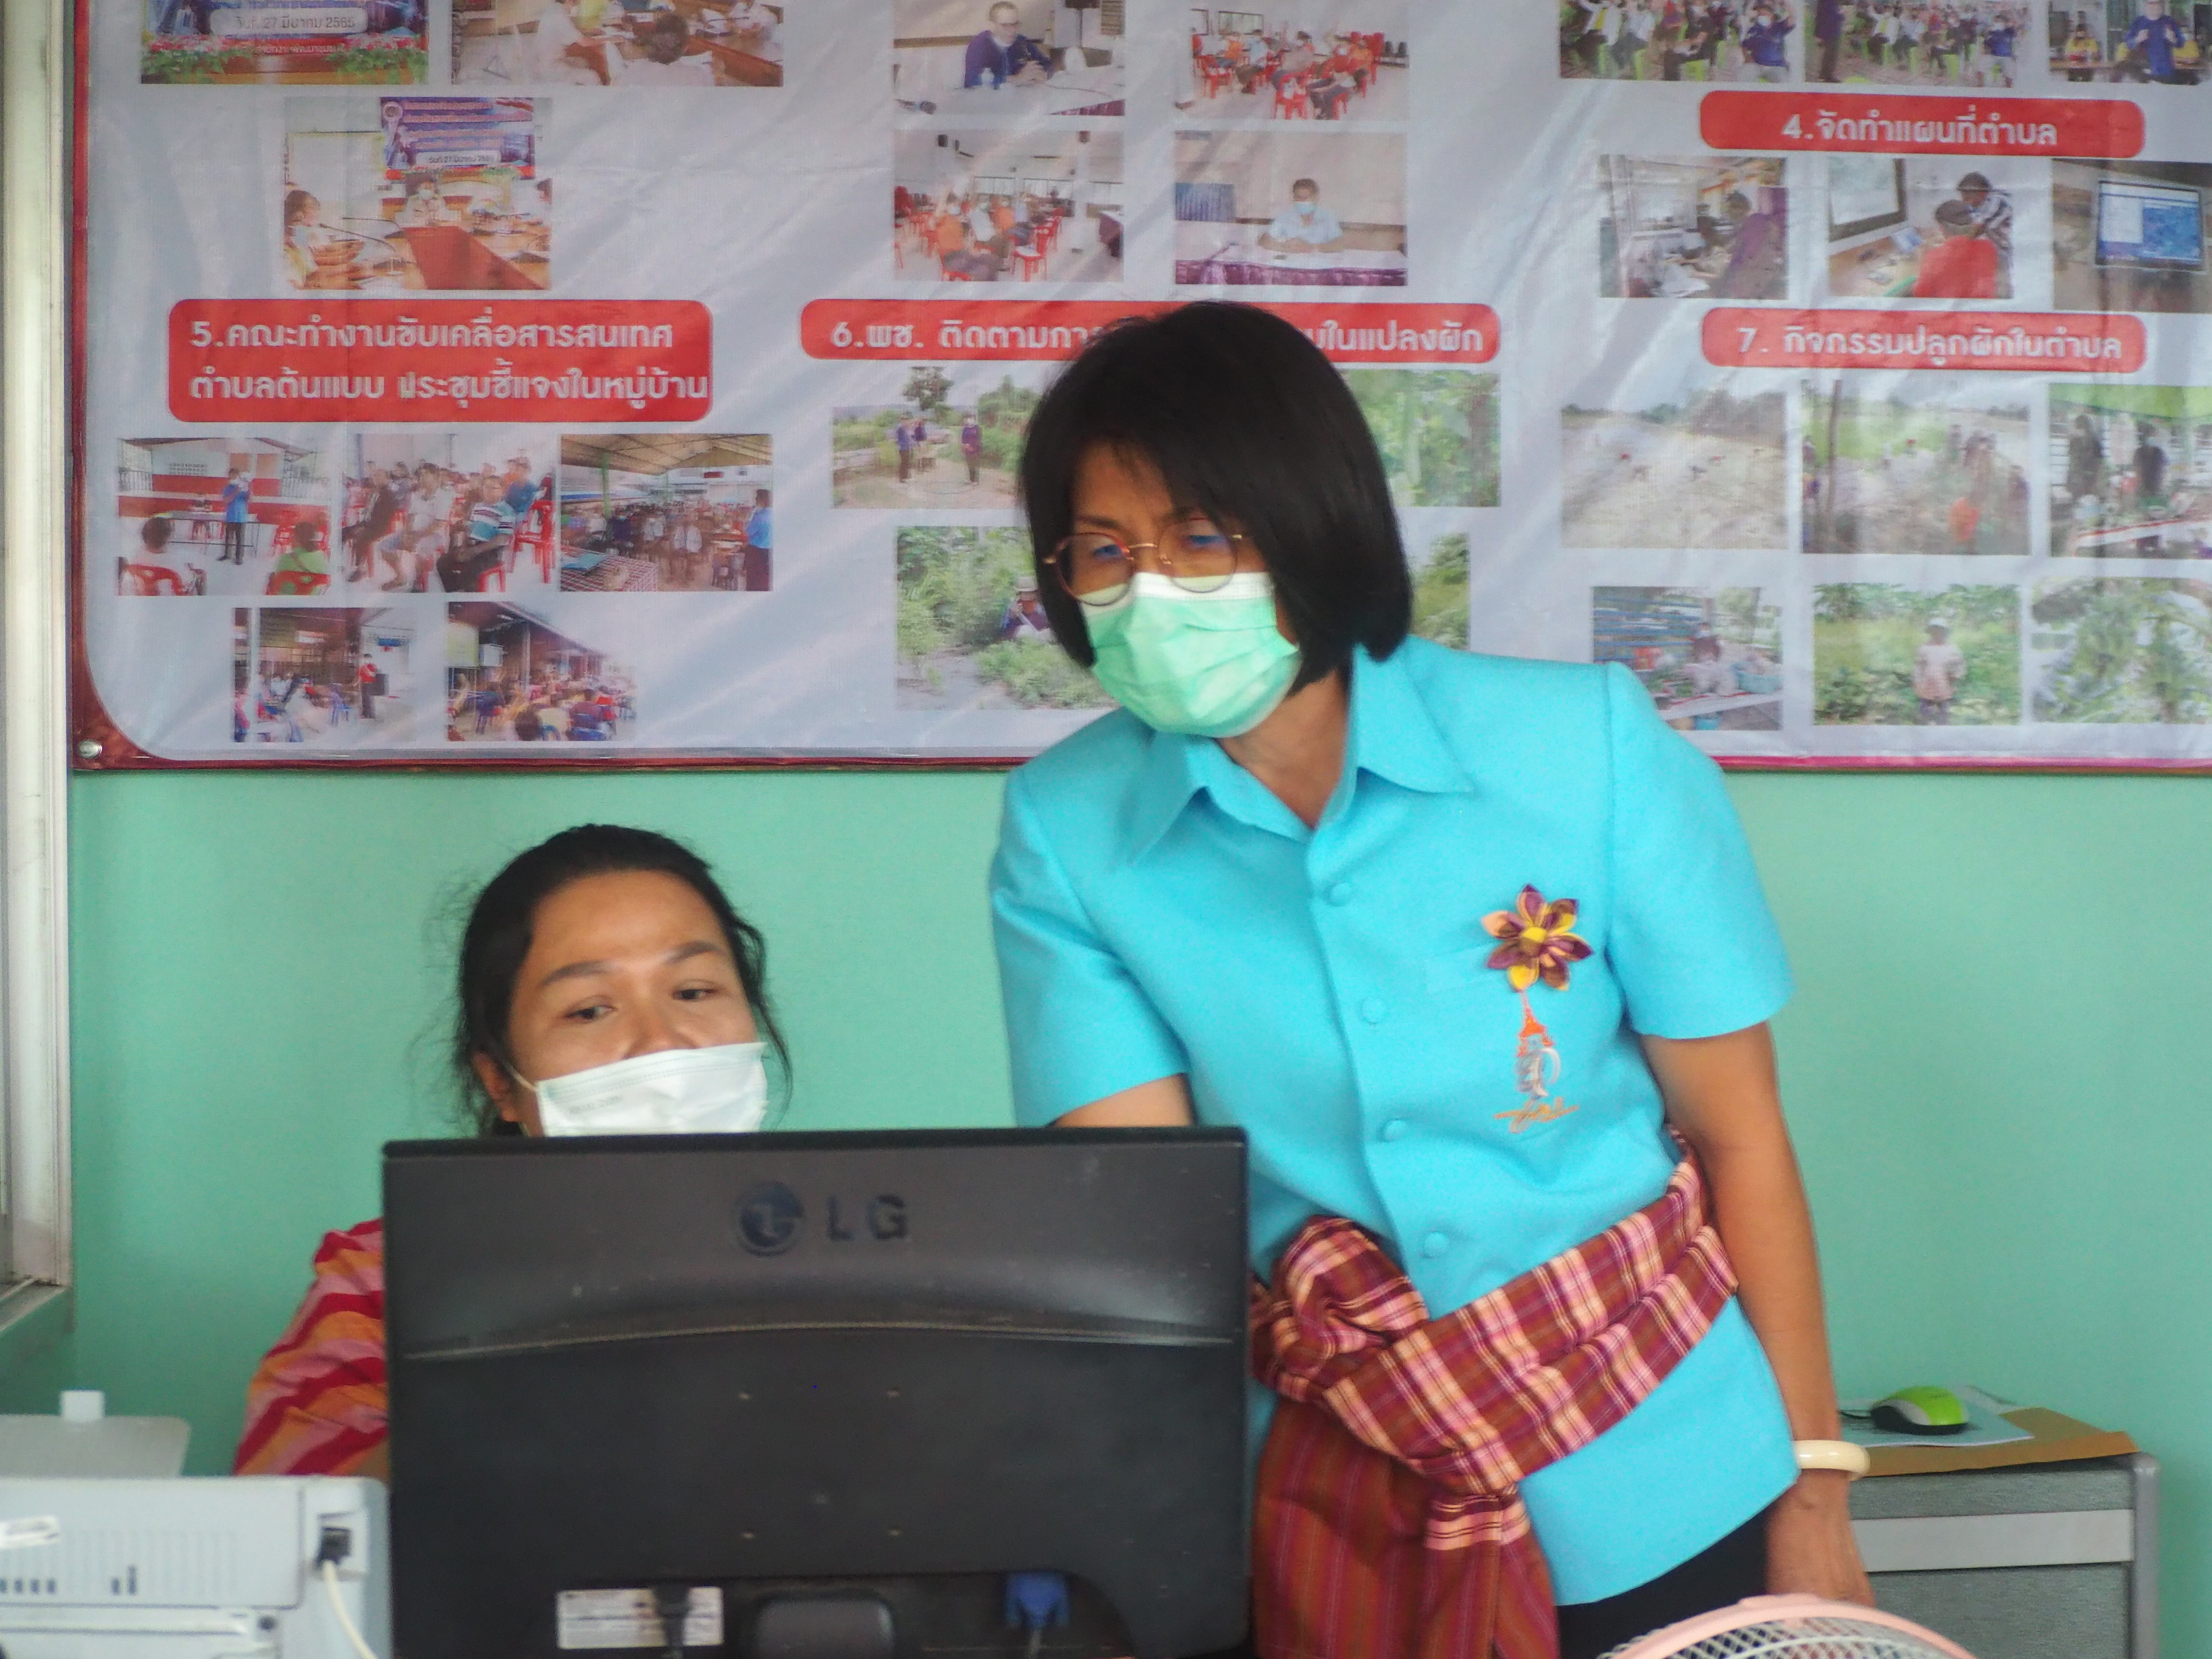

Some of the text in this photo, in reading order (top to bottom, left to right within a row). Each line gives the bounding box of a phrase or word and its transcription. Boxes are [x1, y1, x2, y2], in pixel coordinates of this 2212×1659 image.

[1738, 325, 2122, 366] 7. กิจกรรมปลูกผักในตำบล
[190, 358, 708, 409] ตำบลต้นแบบ ประชุมชี้แจงในหมู่บ้าน
[827, 1193, 908, 1241] LG
